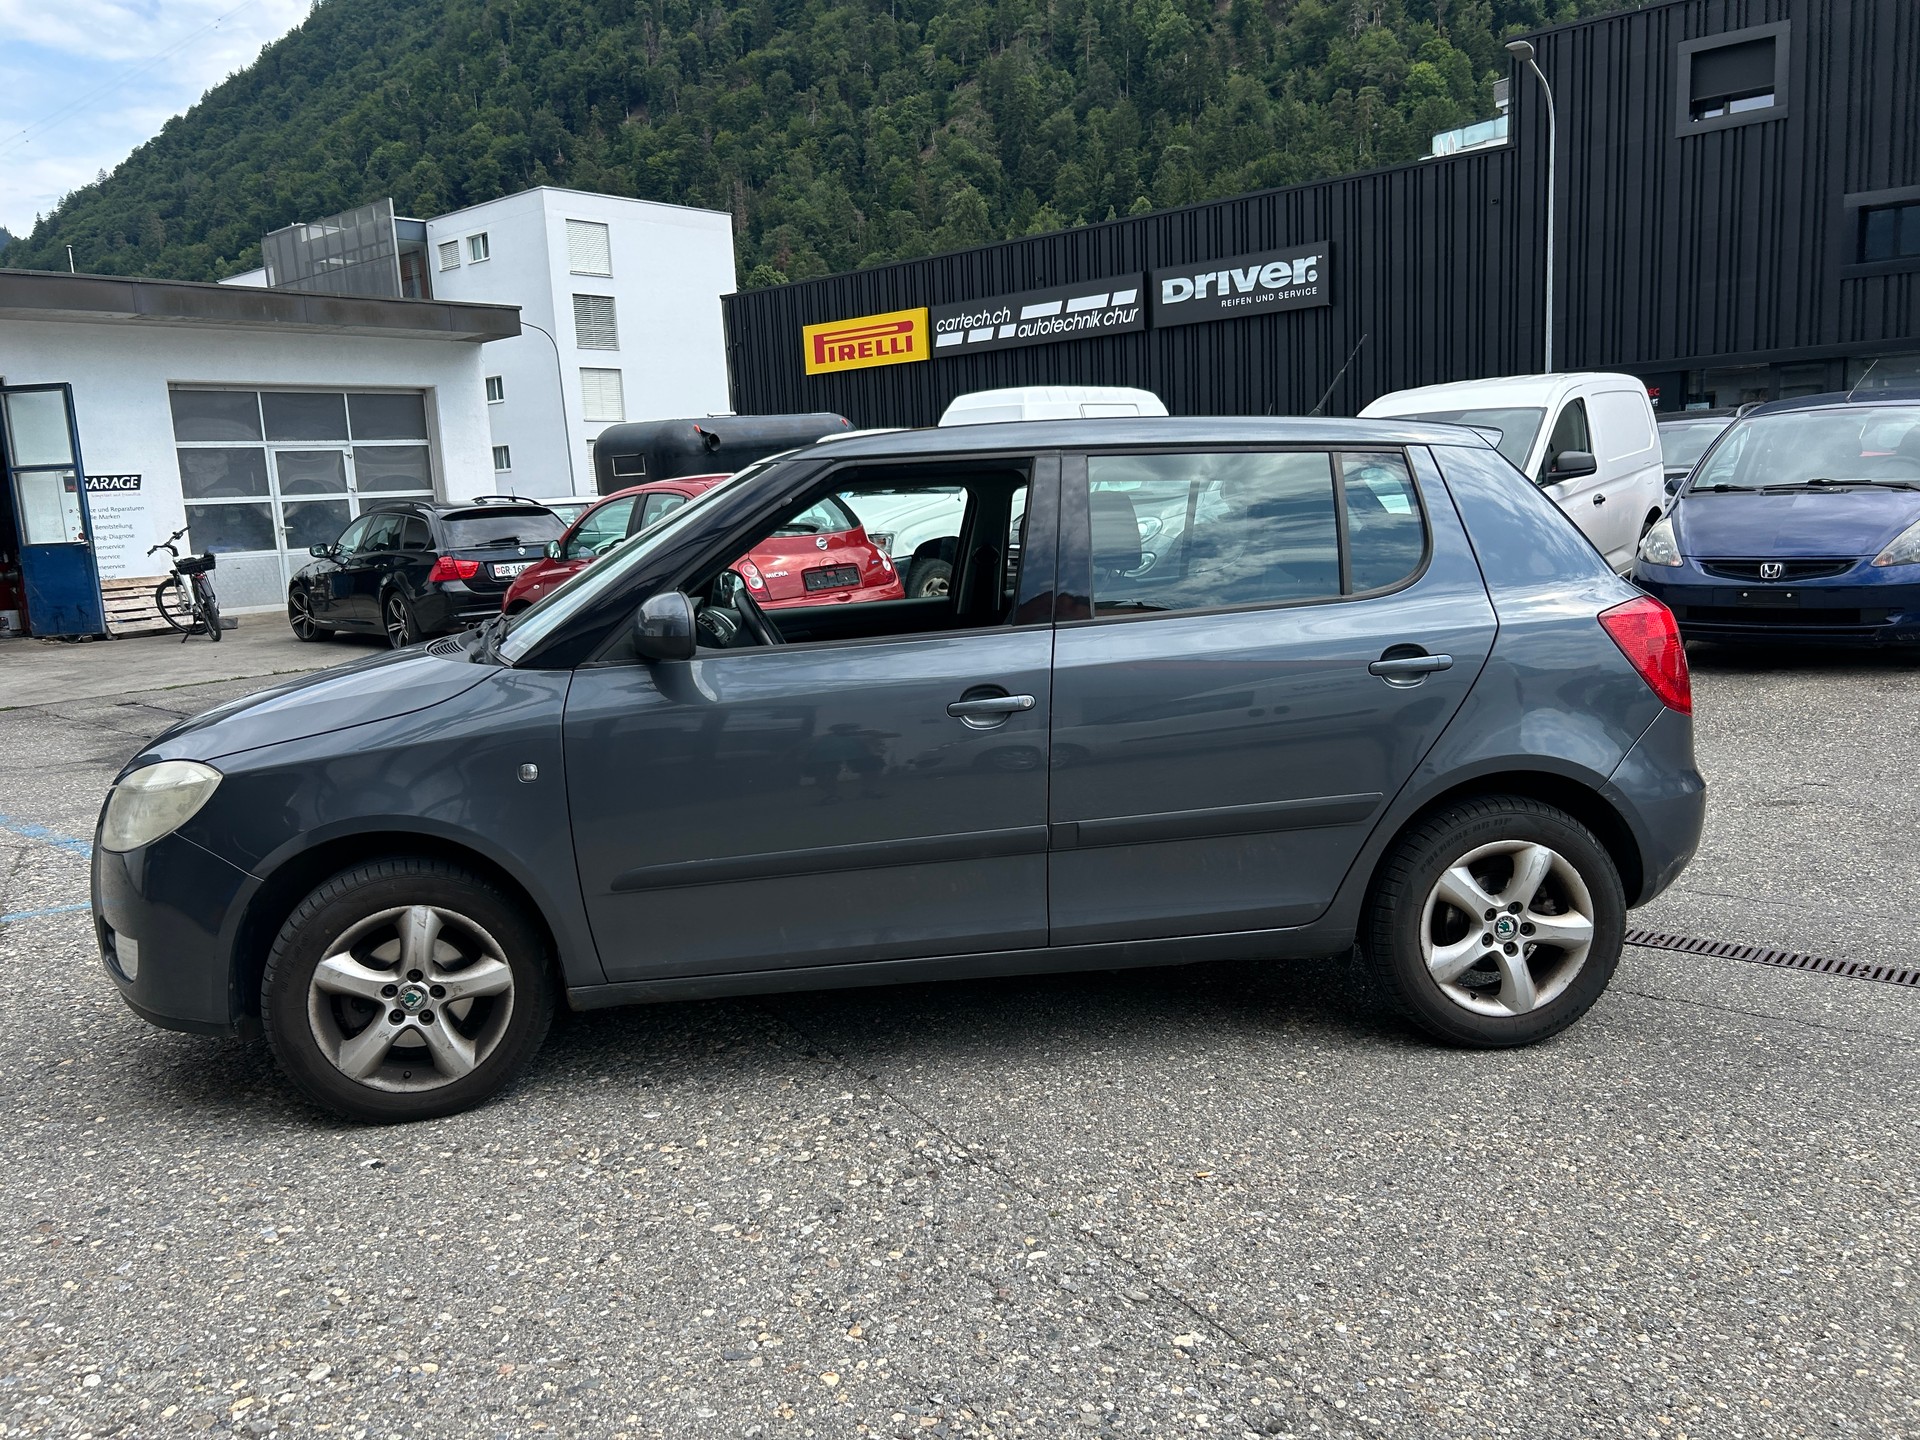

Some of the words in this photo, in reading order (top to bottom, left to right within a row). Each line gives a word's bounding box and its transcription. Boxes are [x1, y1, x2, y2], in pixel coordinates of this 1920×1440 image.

[1221, 296, 1252, 308] REIFEN
[1255, 293, 1275, 303] UND
[1278, 287, 1318, 299] SERVICE
[936, 306, 1011, 333] cartech.ch
[1017, 311, 1102, 338] autotechnik
[1103, 307, 1139, 326] chur
[813, 320, 914, 365] PIRELLI
[765, 570, 789, 579] MICRA
